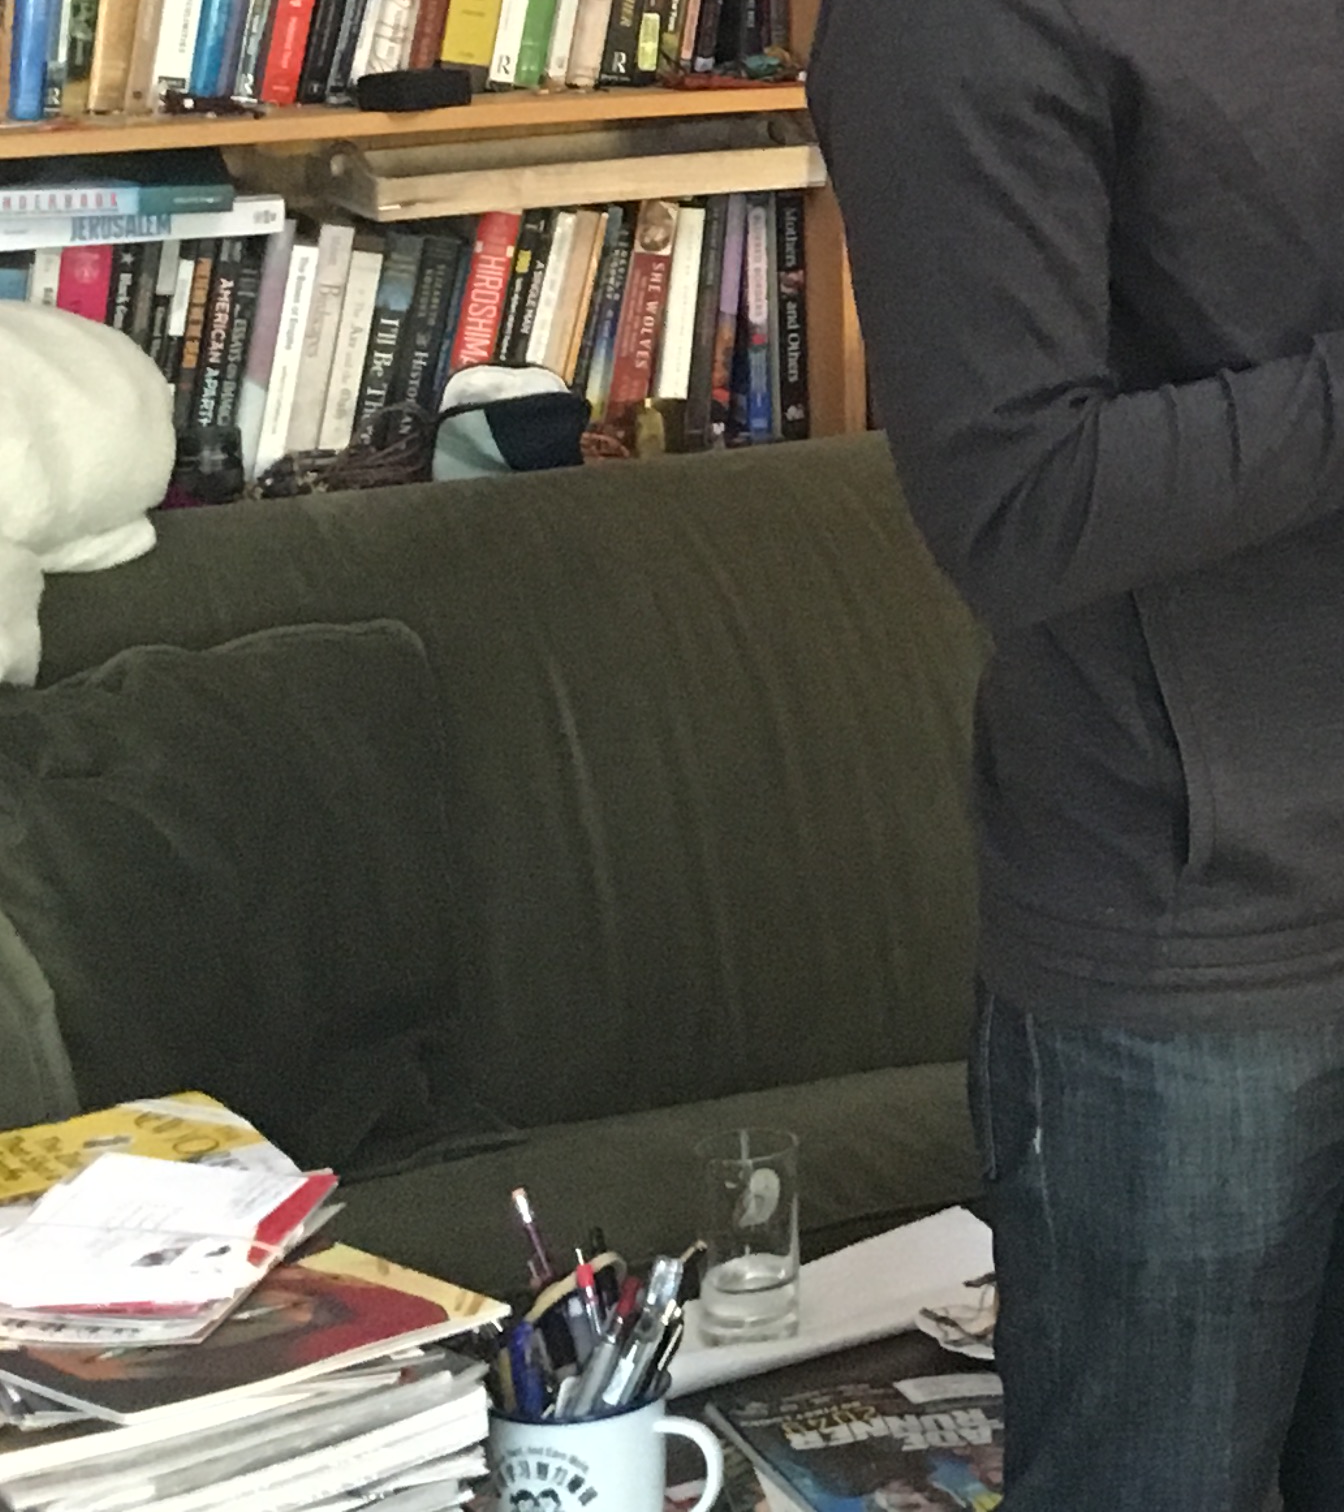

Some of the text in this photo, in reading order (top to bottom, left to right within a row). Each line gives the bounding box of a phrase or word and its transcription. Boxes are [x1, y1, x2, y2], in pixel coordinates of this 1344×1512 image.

[70, 214, 172, 242] JERUSALEM
[208, 277, 235, 364] AMERICAN
[525, 270, 544, 310] SINGLE
[635, 262, 666, 370] SHE WOLVES
[784, 207, 801, 383] Mothers and Others
[370, 317, 400, 378] I'll Be
[520, 310, 533, 335] MAN
